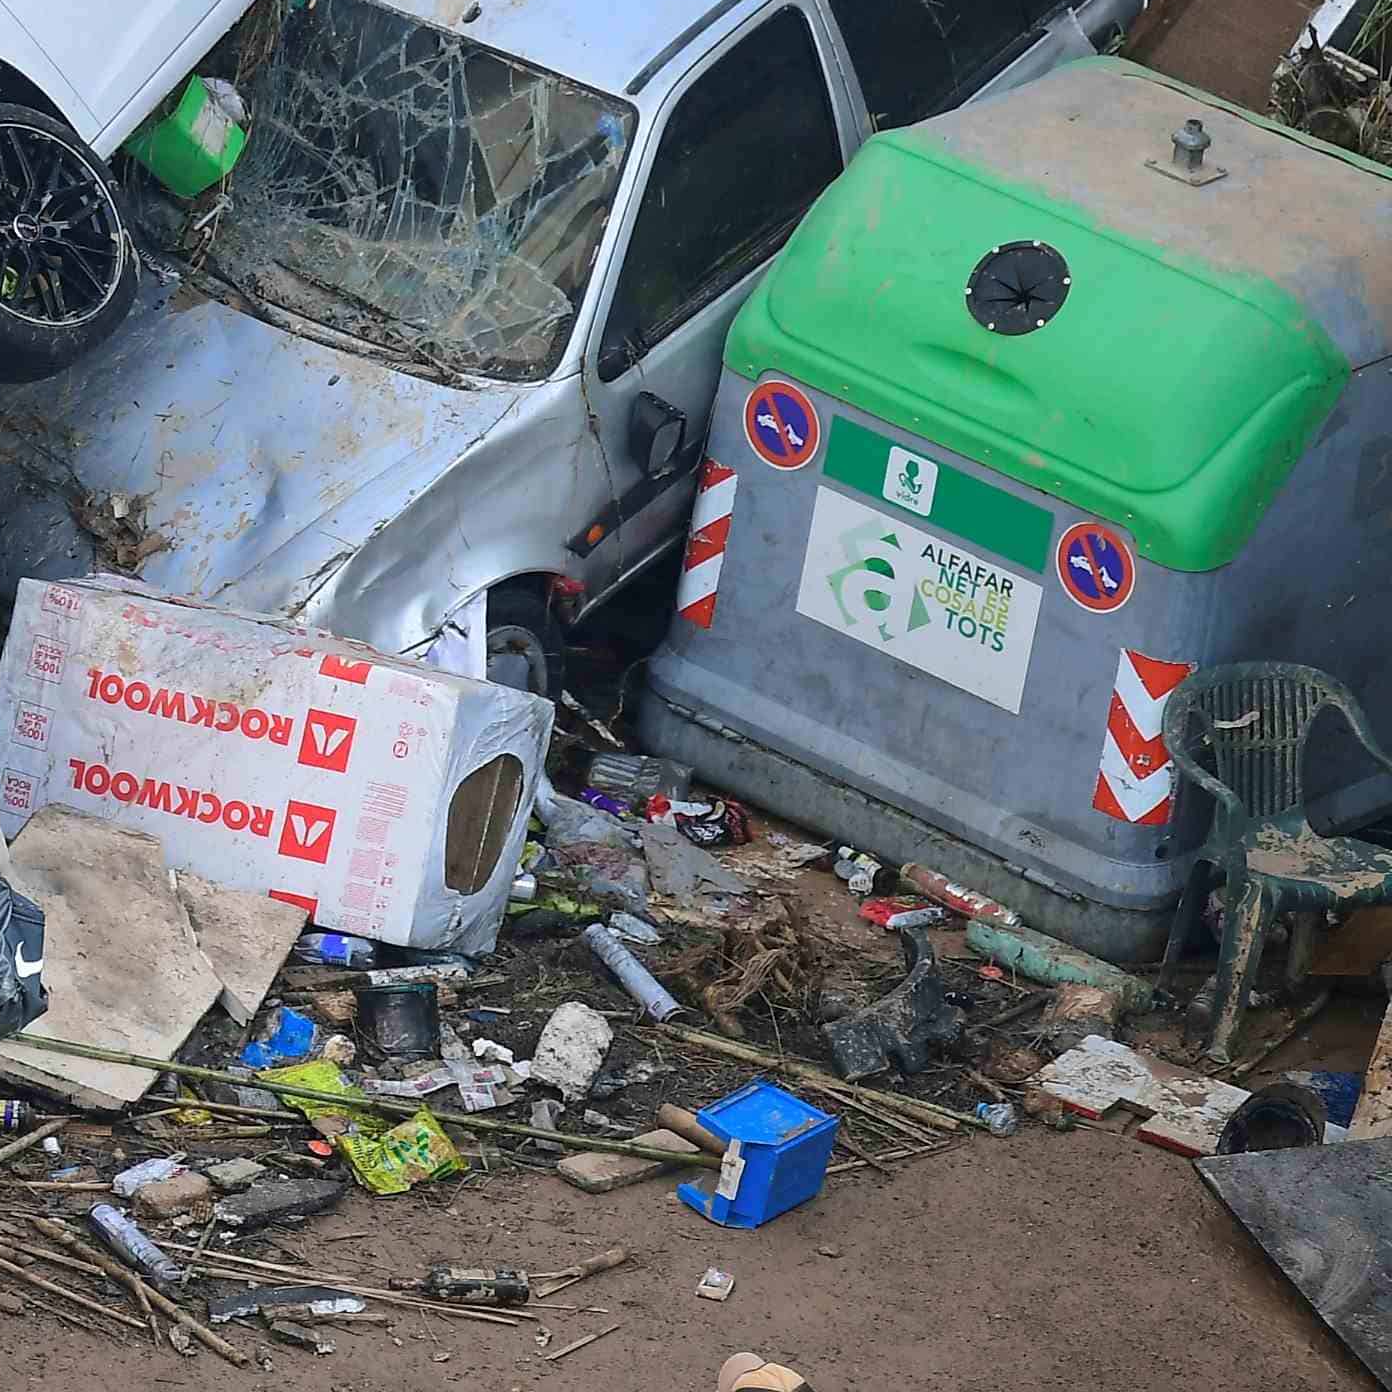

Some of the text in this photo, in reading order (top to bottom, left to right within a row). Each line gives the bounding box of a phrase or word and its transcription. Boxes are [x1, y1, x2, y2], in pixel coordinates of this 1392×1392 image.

[920, 543, 1014, 598] ALFAFAR
[938, 568, 1009, 613] NET ES
[944, 608, 1006, 652] TOTS
[34, 658, 59, 674] 100%
[87, 669, 294, 746] ROCKWOOL
[17, 725, 43, 740] 100%
[3, 792, 28, 808] 100%
[7, 775, 31, 790] ROCA
[69, 758, 274, 837] ROCKWOOL
